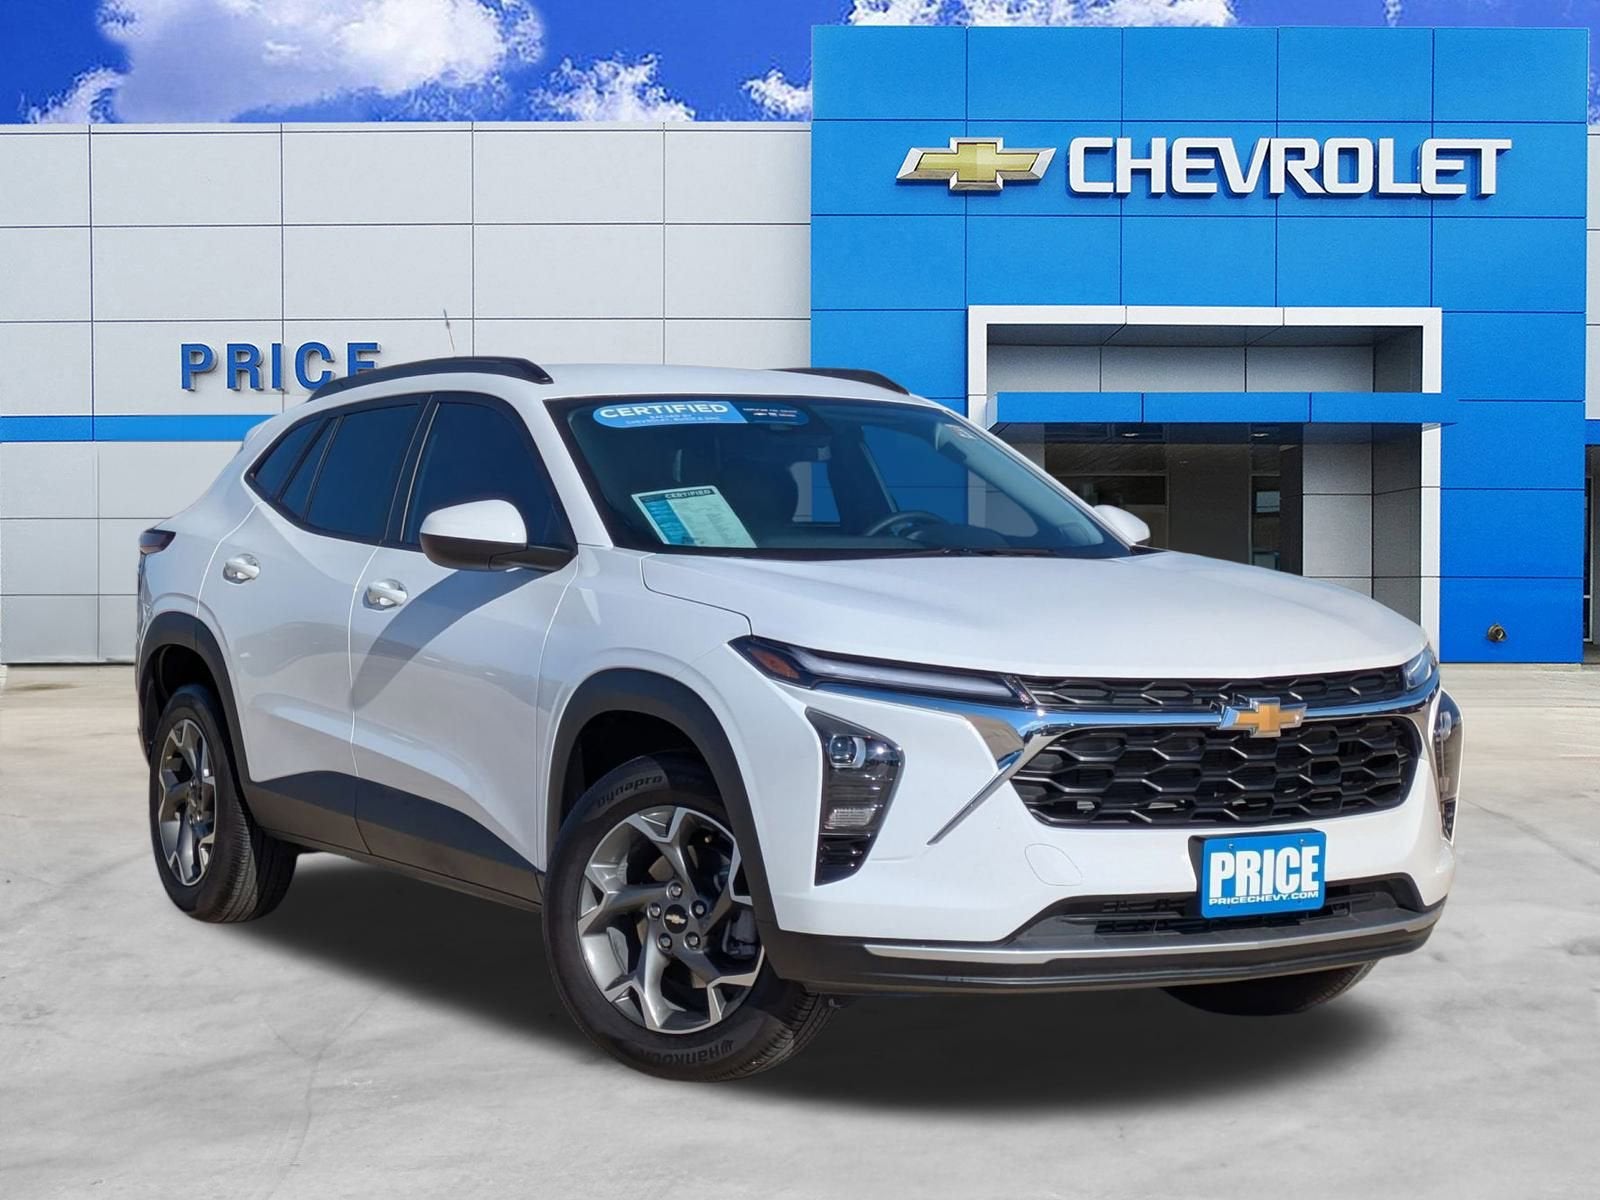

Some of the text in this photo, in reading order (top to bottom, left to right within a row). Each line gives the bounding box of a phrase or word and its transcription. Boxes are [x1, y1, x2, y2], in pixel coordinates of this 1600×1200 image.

[1069, 137, 1512, 195] CHEVROLET
[181, 342, 381, 391] PRICE
[600, 404, 728, 418] CERTIFIED
[1209, 845, 1320, 898] PRICE
[1208, 890, 1320, 906] PRICECHEVY.COM
